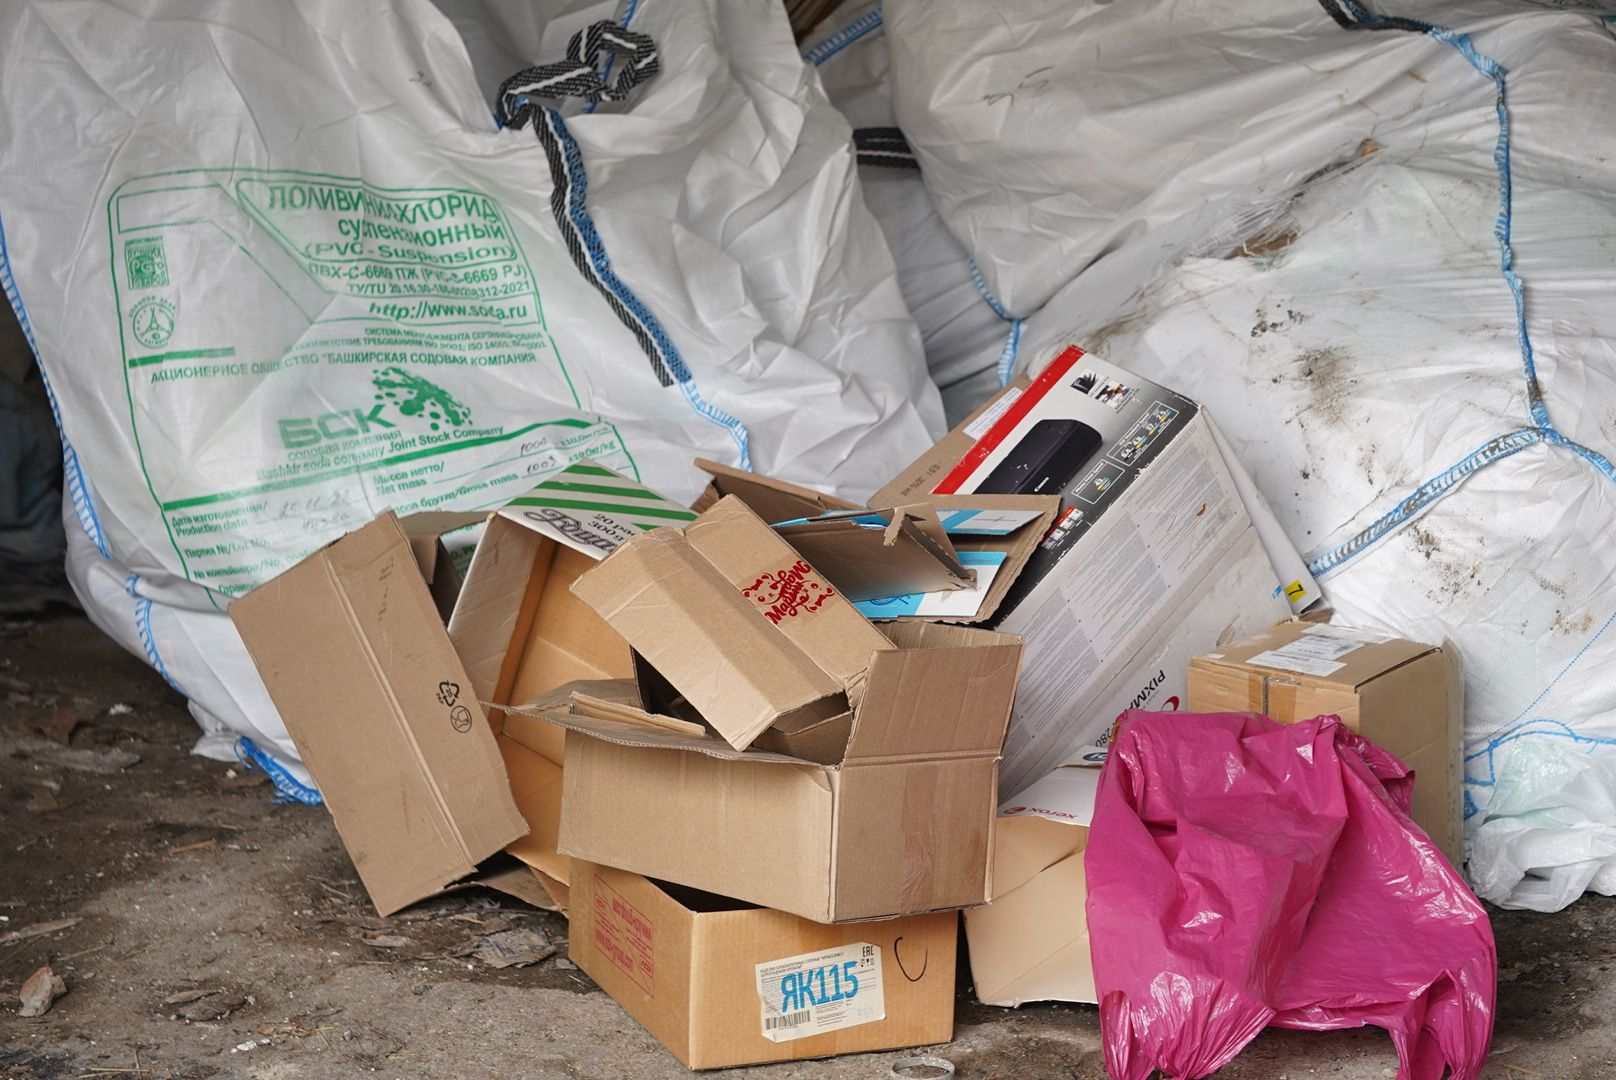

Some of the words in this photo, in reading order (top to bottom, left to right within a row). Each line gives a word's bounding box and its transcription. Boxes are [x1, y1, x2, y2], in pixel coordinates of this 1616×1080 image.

[151, 363, 248, 384] АКЦИОНЕРНОЕ
[410, 352, 468, 365] СОДОВАЯ
[389, 439, 417, 455] Joint
[418, 430, 450, 445] Stock
[452, 425, 503, 440] Company
[398, 478, 428, 491] mass
[490, 472, 519, 486] mass
[175, 523, 222, 538] Production
[1030, 807, 1078, 819] xerox
[780, 961, 859, 1013] ЯК115
